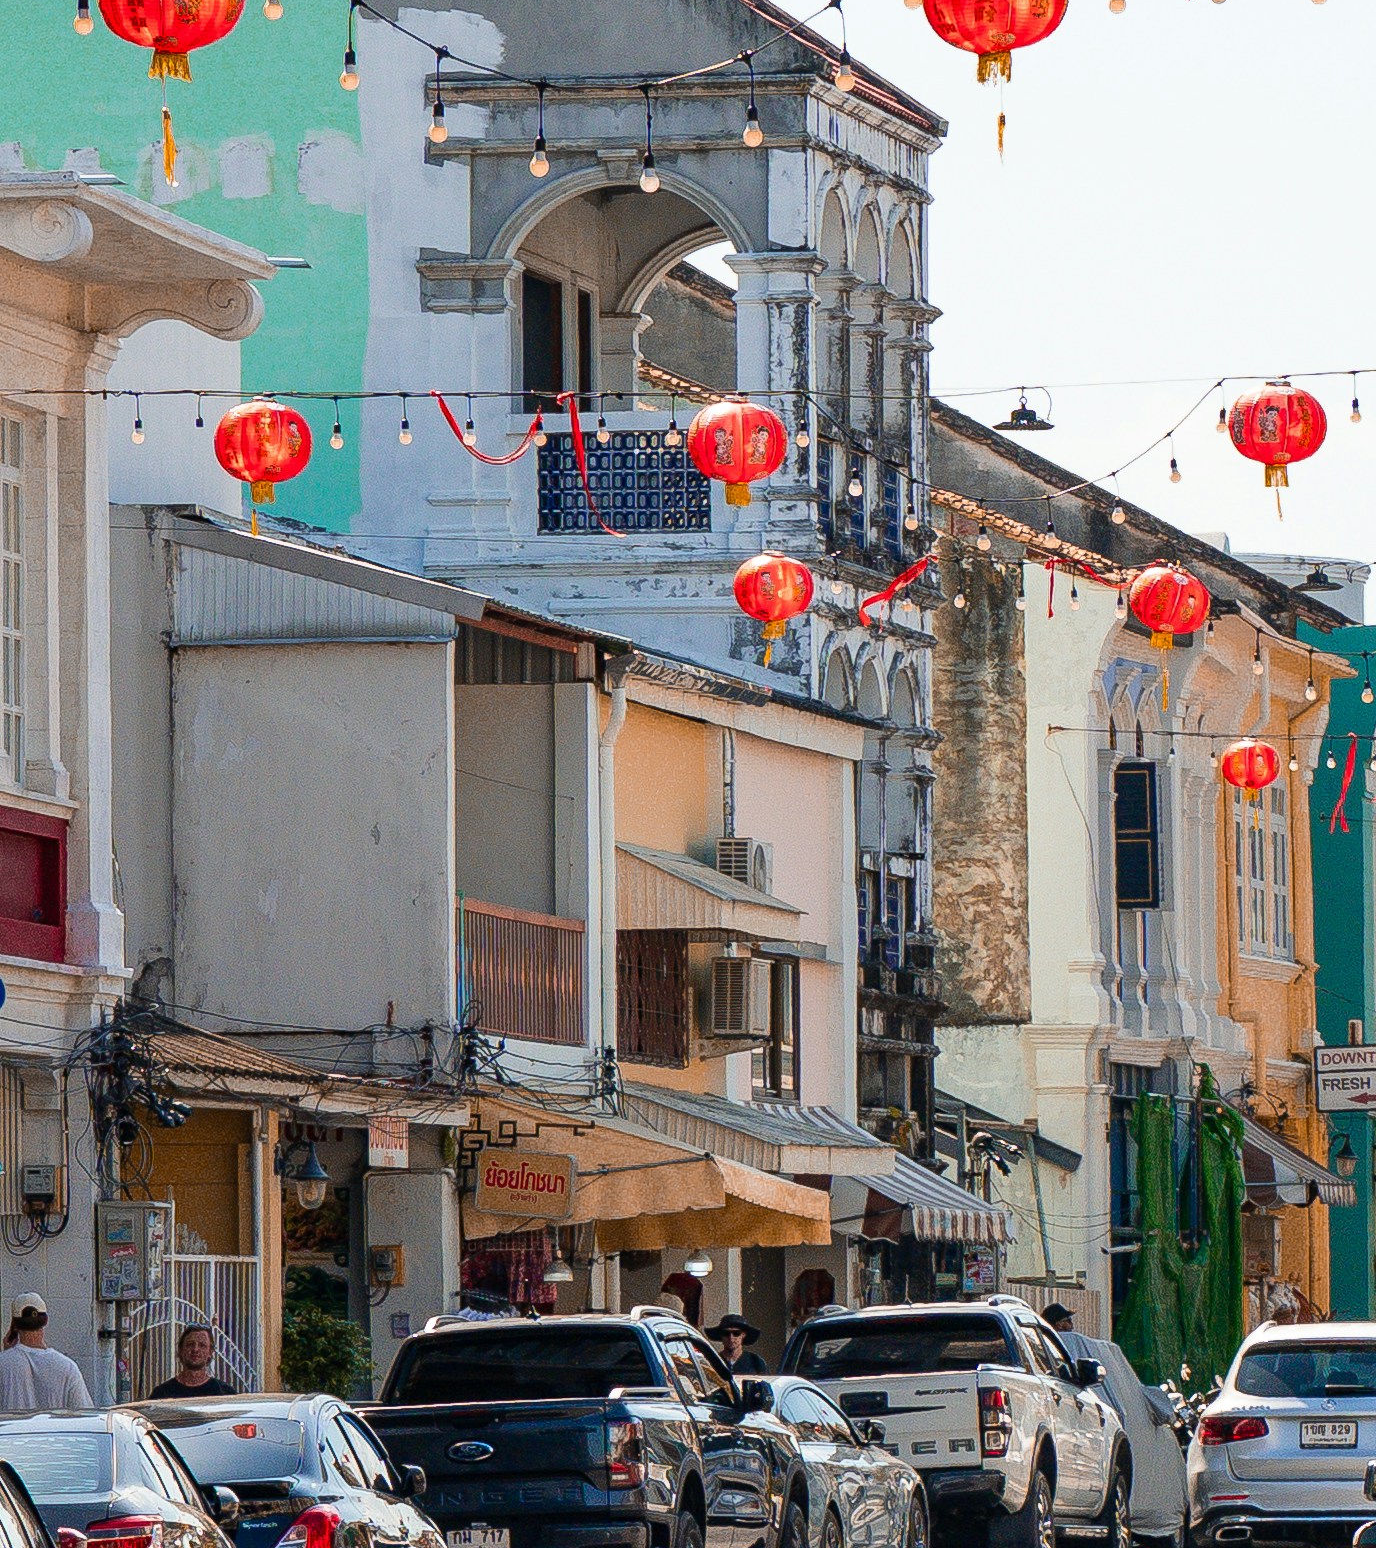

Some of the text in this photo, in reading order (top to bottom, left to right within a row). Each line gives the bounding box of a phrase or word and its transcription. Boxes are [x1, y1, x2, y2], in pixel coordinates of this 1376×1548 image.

[1322, 1076, 1371, 1092] FRESH
[1330, 1424, 1351, 1436] 829
[482, 1528, 504, 1544] 717
